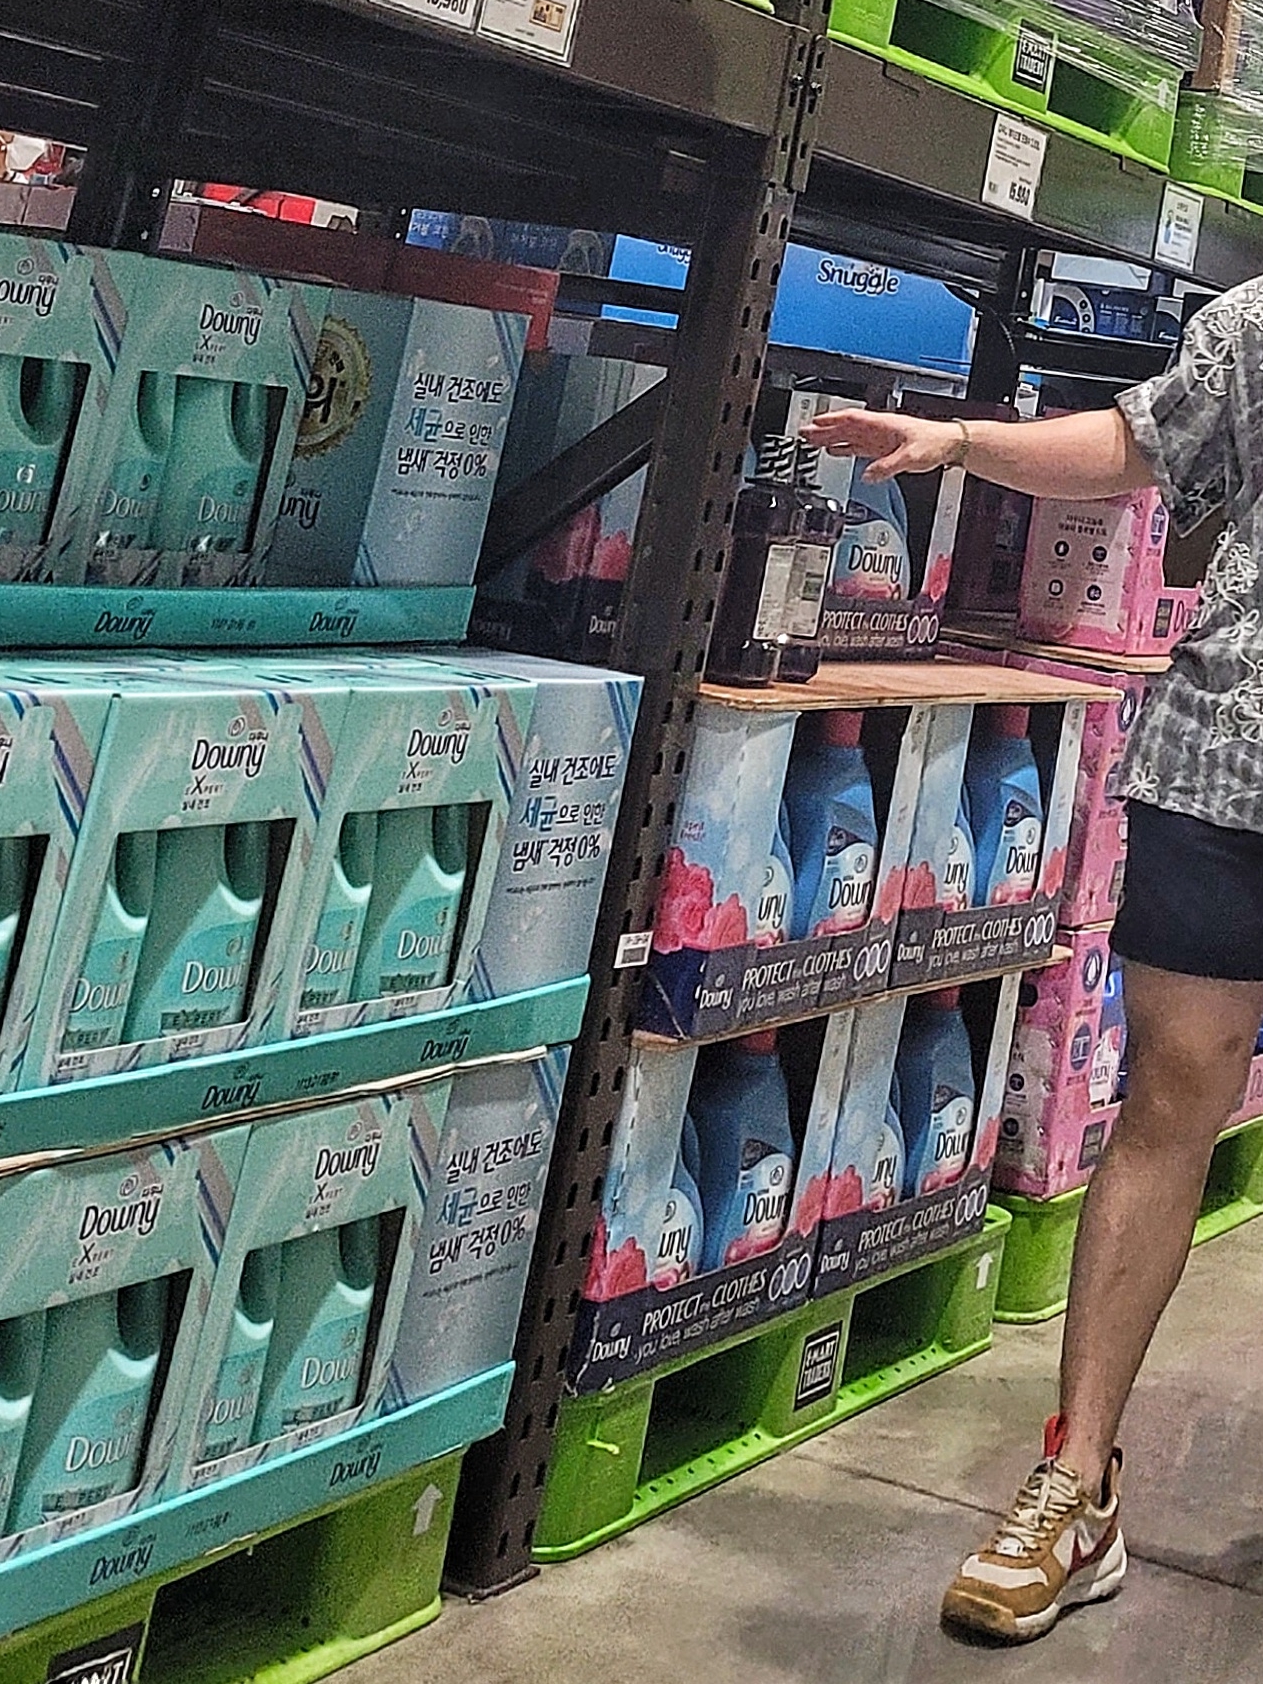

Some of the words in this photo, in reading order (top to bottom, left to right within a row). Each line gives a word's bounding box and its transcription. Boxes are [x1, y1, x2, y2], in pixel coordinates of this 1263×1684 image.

[818, 260, 900, 296] Snuggle
[0, 278, 57, 317] owny
[199, 303, 262, 346] Downy
[413, 372, 445, 401] 실내
[446, 375, 505, 404] 건조에도
[403, 406, 466, 443] 세균으로
[468, 423, 493, 447] 인한
[397, 447, 428, 477] 냄새
[433, 450, 463, 480] 걱정
[462, 453, 488, 478] 0%
[848, 543, 902, 584] Downy
[94, 611, 153, 641] Downy
[308, 611, 358, 637] Downy
[589, 614, 617, 635] Down
[821, 610, 866, 630] PROTECT
[869, 613, 909, 632] CLOTHES
[191, 739, 266, 778] Downy
[406, 729, 470, 765] Downy
[529, 757, 560, 789] 실내
[561, 754, 617, 786] 건조에도
[519, 795, 580, 832] 세균으로
[583, 803, 606, 826] 인한
[512, 840, 543, 872] 냄새
[548, 837, 577, 868] 걱정
[577, 832, 601, 860] 0%
[1006, 846, 1039, 875] Down
[758, 891, 787, 929] wny
[827, 877, 872, 911] Down
[398, 929, 445, 960] Dow
[931, 927, 974, 951] PROTECT
[980, 917, 1023, 940] CLOTHES
[741, 958, 796, 992] PROTECT
[801, 946, 853, 977] CLOTHES
[896, 942, 926, 964] Downy
[69, 977, 129, 1013] Dow
[181, 960, 244, 995] Dow
[698, 987, 734, 1010] Downy
[420, 1034, 472, 1063] Downy
[201, 1080, 261, 1111] Downy
[314, 1142, 381, 1181] Downy
[446, 1146, 481, 1185] 실내
[482, 1129, 542, 1175] 건조에도
[933, 1131, 968, 1163] Down
[79, 1196, 162, 1241] Downy
[435, 1186, 503, 1228] 세균으로
[506, 1181, 532, 1211] 인한
[743, 1192, 789, 1227] Down
[428, 1236, 463, 1275] 냄새
[467, 1222, 500, 1261] 걱정
[500, 1213, 527, 1247] 0%
[657, 1223, 693, 1264] wny
[857, 1219, 905, 1252] PROTECT
[911, 1200, 954, 1230] CLOTHES
[821, 1249, 851, 1274] Downy
[641, 1292, 703, 1338] PROTECT
[711, 1268, 768, 1310] CLOTHES
[592, 1334, 632, 1363] Downy
[330, 1449, 383, 1487] Downy
[89, 1544, 154, 1586] Downy
